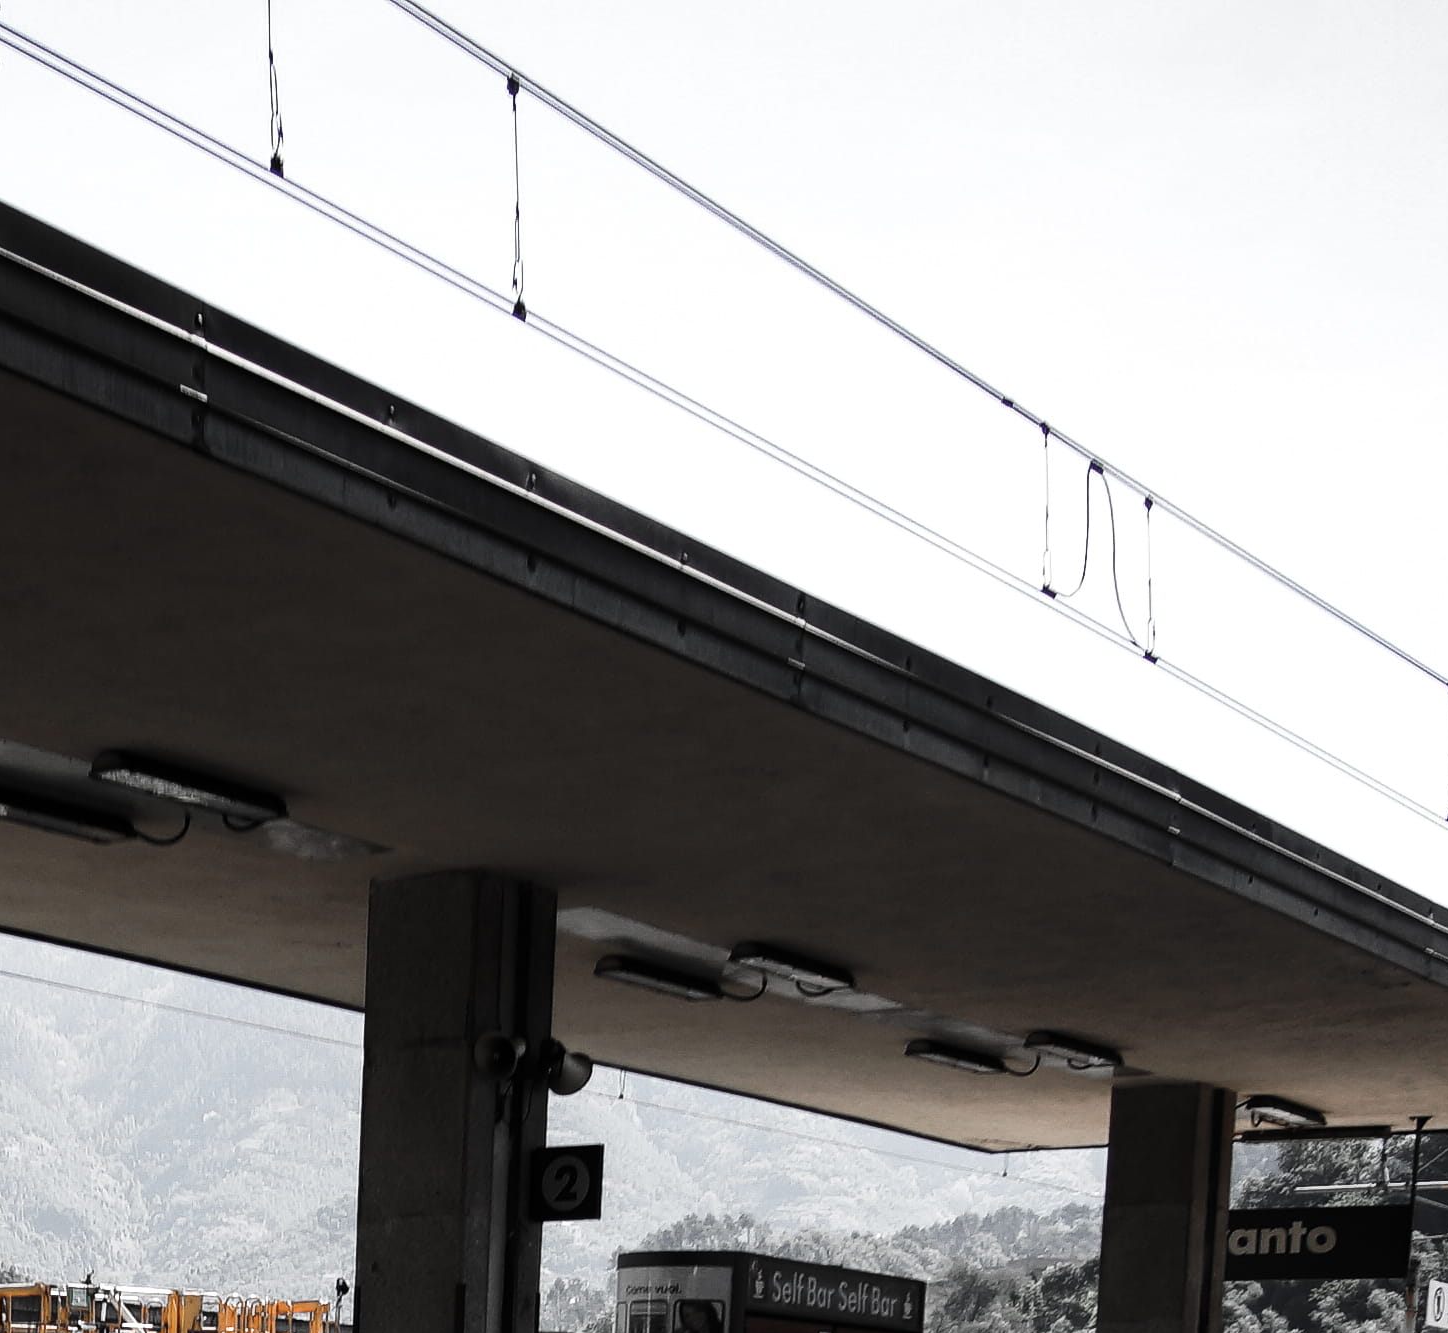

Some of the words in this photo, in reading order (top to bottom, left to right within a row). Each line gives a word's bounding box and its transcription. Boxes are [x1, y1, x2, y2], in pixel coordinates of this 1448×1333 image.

[555, 1166, 578, 1201] 2
[1227, 1220, 1338, 1256] anto
[771, 1270, 804, 1305] Self
[806, 1276, 835, 1309] Bar
[838, 1281, 870, 1314] Self
[871, 1286, 898, 1318] Bar
